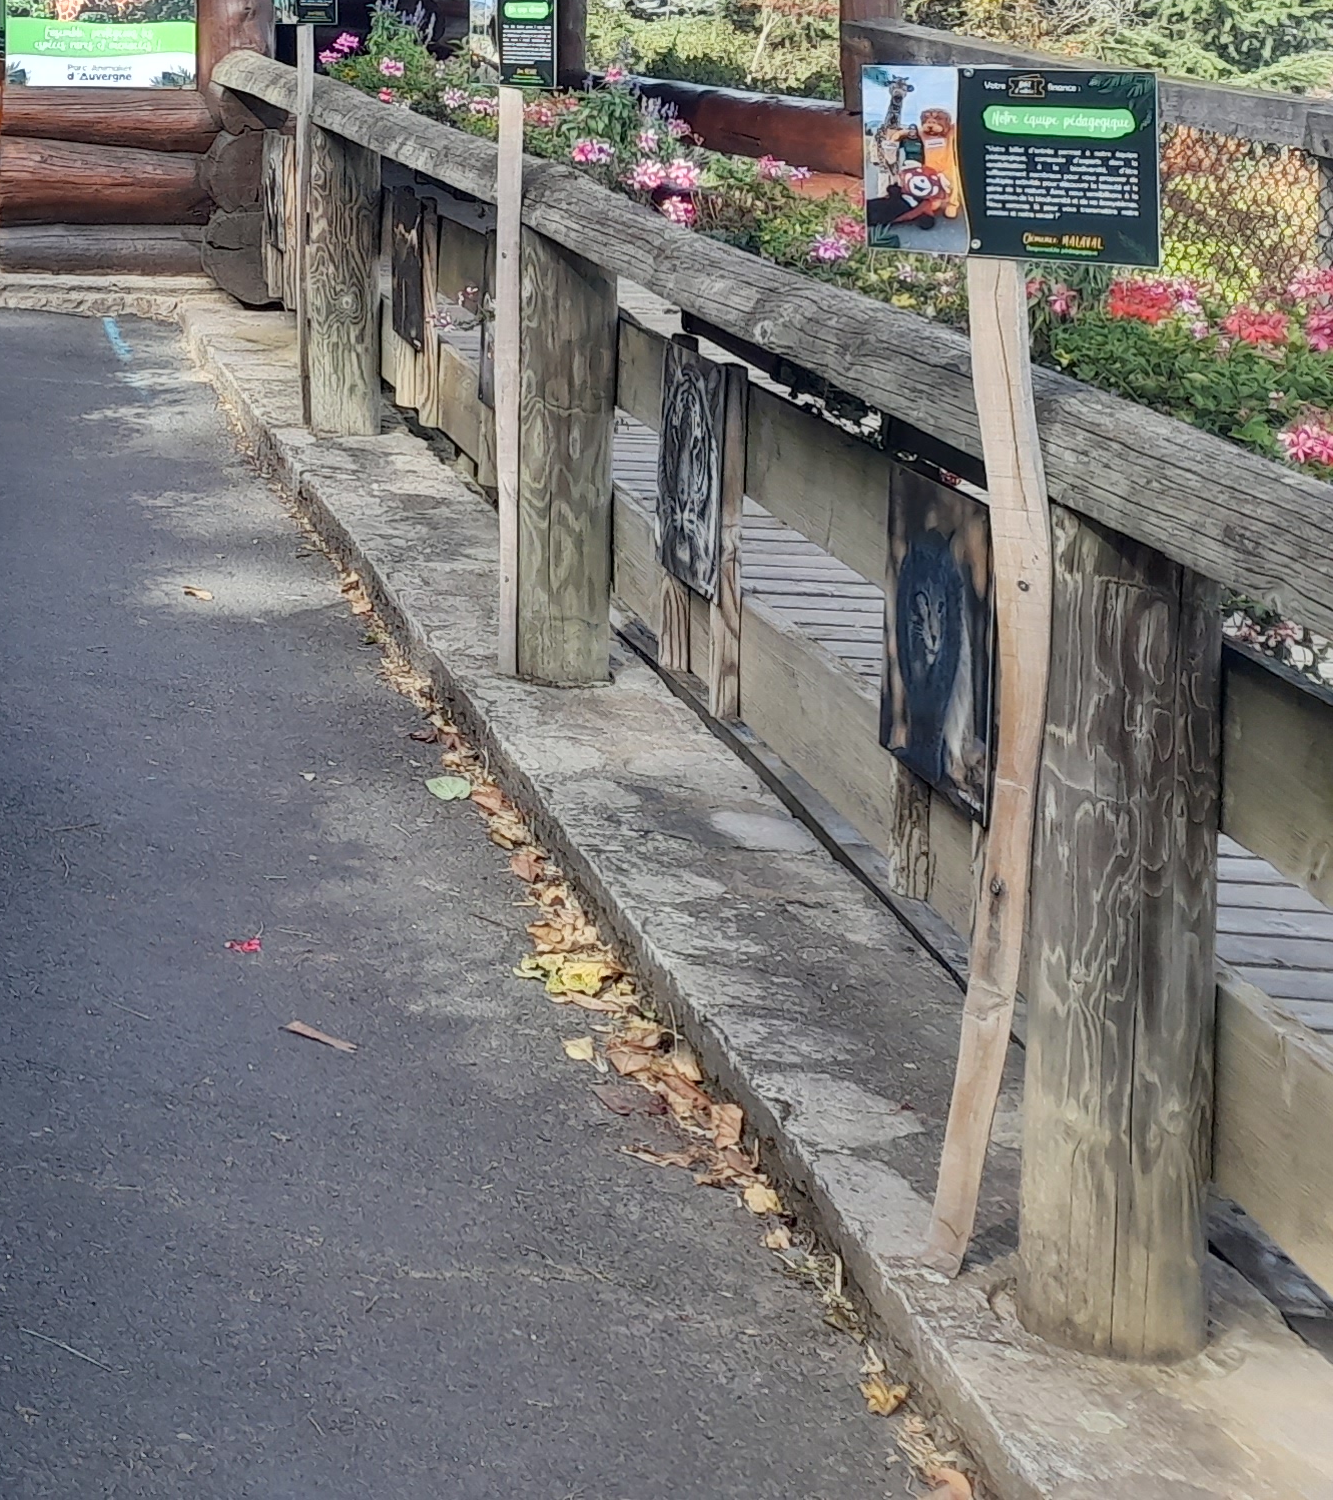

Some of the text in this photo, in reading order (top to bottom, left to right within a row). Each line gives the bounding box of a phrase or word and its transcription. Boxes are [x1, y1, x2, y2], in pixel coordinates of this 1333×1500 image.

[984, 80, 1006, 90] Votre
[991, 111, 1131, 133] Notre équipe pédagogique
